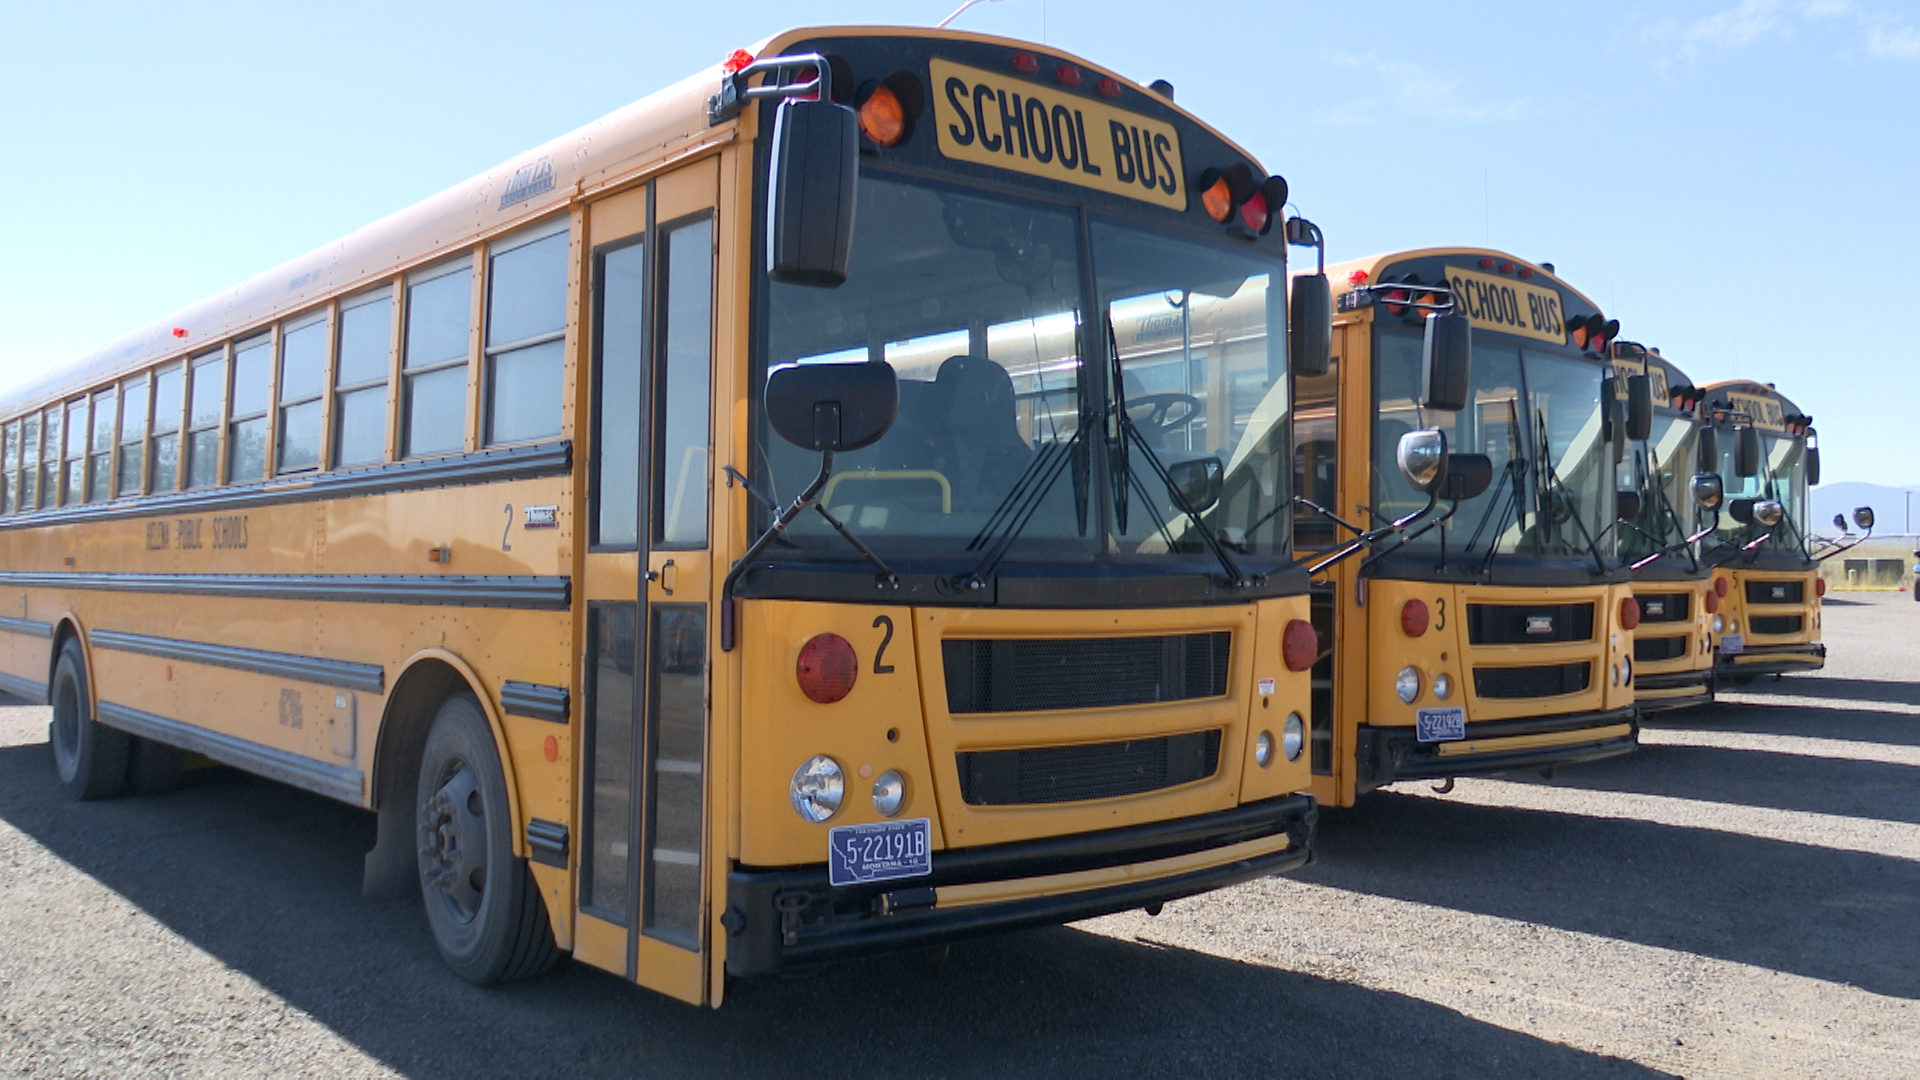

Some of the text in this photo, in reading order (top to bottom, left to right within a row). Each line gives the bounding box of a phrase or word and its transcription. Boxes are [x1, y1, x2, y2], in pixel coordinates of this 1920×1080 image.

[945, 77, 1176, 195] SCHOOL BUS
[1452, 276, 1561, 336] SCHOOL BUS
[213, 516, 248, 549] SCHOOLS
[502, 503, 514, 552] 2
[1732, 571, 1738, 589] 5
[1435, 597, 1446, 632] 3
[872, 614, 895, 674] 2
